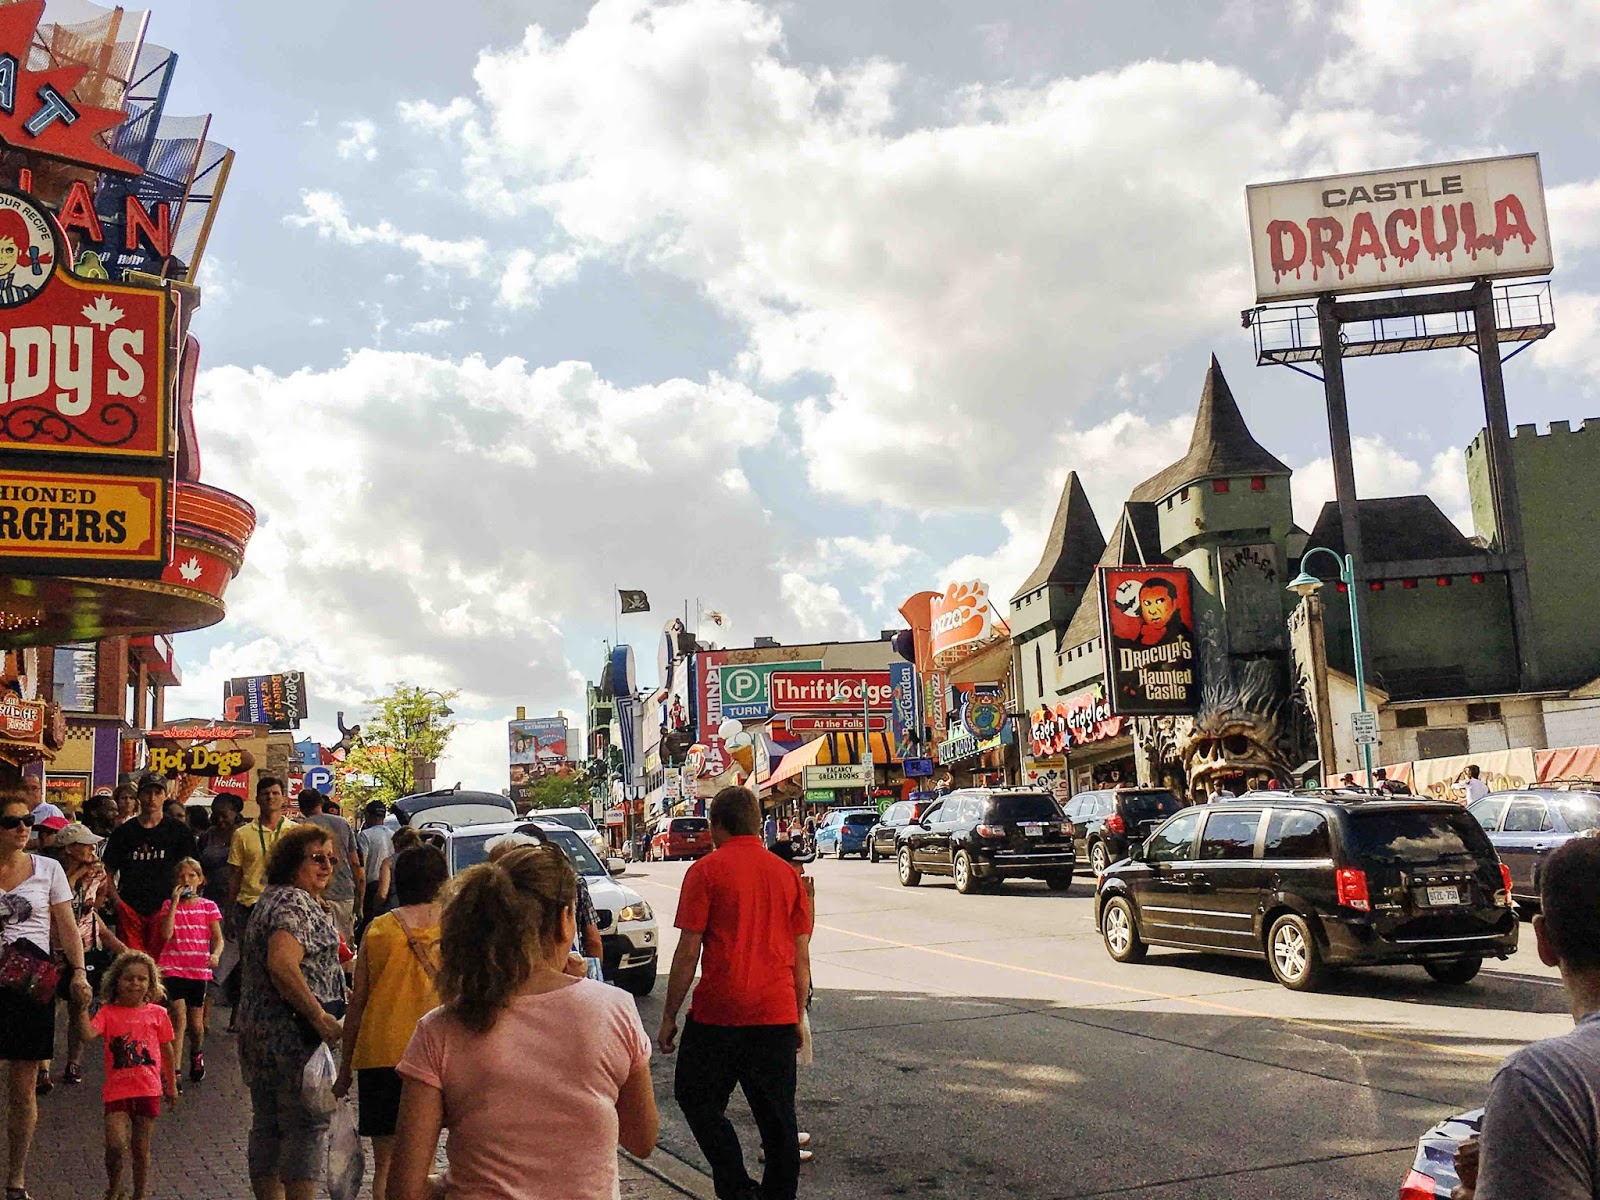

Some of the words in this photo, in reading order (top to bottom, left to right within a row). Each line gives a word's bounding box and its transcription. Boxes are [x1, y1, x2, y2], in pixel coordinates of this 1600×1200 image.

[1321, 175, 1464, 208] CASTLE
[22, 207, 50, 241] RECIPE
[1266, 194, 1537, 285] DRACULA
[0, 506, 127, 543] RGERS
[774, 678, 892, 699] Thriftlodge
[899, 667, 913, 709] Garden
[1138, 668, 1192, 686] Haunted
[1146, 684, 1187, 700] Castle
[729, 705, 762, 716] TURN
[814, 719, 824, 728] At
[826, 719, 841, 728] the
[843, 719, 864, 728] Falls
[1032, 719, 1055, 747] Gags
[149, 747, 187, 774] Hot
[191, 746, 243, 776] Dogs
[214, 776, 247, 790] Hortons
[819, 772, 838, 780] GREAT
